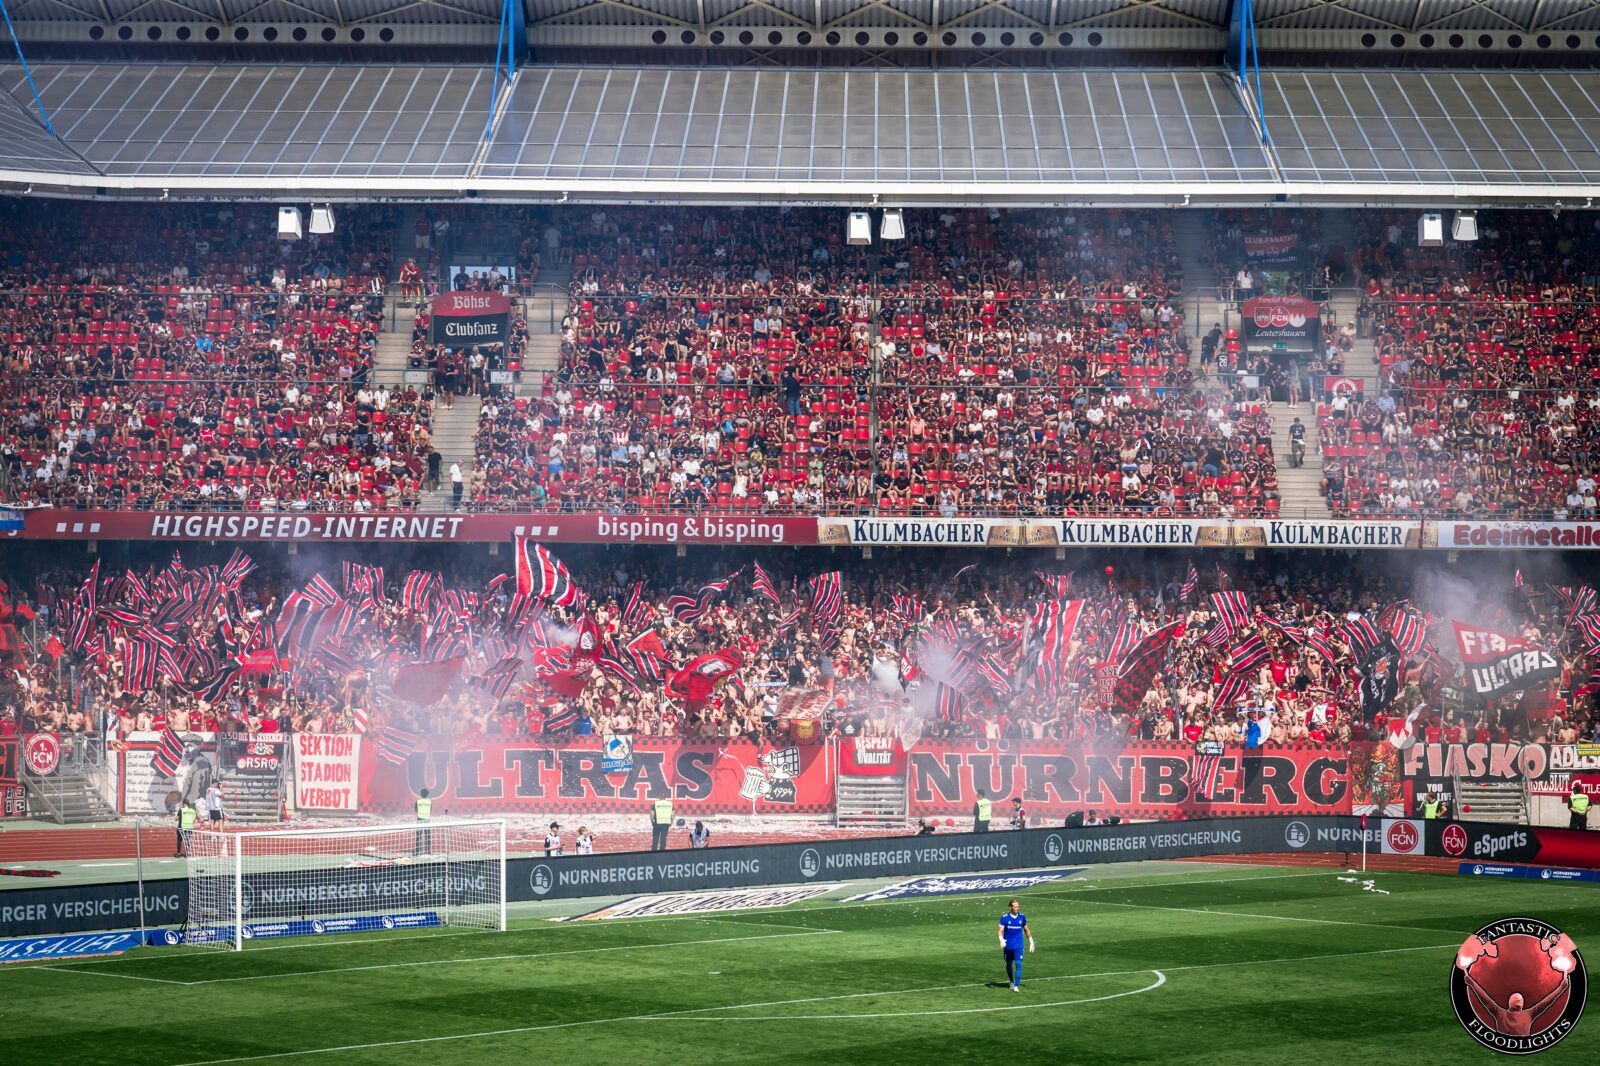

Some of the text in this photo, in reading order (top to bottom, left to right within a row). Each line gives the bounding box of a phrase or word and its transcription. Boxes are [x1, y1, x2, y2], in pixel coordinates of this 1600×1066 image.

[452, 295, 491, 311] Böhse
[445, 322, 498, 336] Clubfanz
[150, 515, 463, 538] HIGHSPEED-INTERNET
[598, 516, 784, 542] bisping & bisping
[853, 519, 985, 543] KULMBACHER
[1061, 520, 1193, 544] KULMBACHER
[1269, 521, 1402, 545] KULMBACHER
[1472, 651, 1557, 693] ULTRAS
[33, 752, 53, 763] FCN
[39, 741, 47, 751] 1.
[300, 735, 353, 757] SEKTION
[301, 762, 351, 783] STADION
[911, 738, 1350, 806] NÜRNBERG
[1404, 742, 1547, 779] FIASKO
[405, 748, 715, 800] ULTRAS
[300, 788, 350, 809] VERBOT
[773, 787, 793, 798] 1994
[1427, 783, 1443, 793] YOU
[1391, 834, 1415, 845] FCN
[1399, 823, 1406, 834] 1.
[1067, 829, 1241, 853] NÜRNBERGER VERSICHERUNG
[1445, 837, 1464, 849] FCN
[1474, 830, 1527, 857] eSports
[826, 844, 1008, 869] NÜRNBERGER VERSICHERUNG
[559, 859, 760, 886] NÜRNBERGER VERSICHERUNG
[261, 876, 487, 903] NÜRNBERGER VERSICHERUNG
[0, 895, 179, 923] RGER VERSICHERUNG
